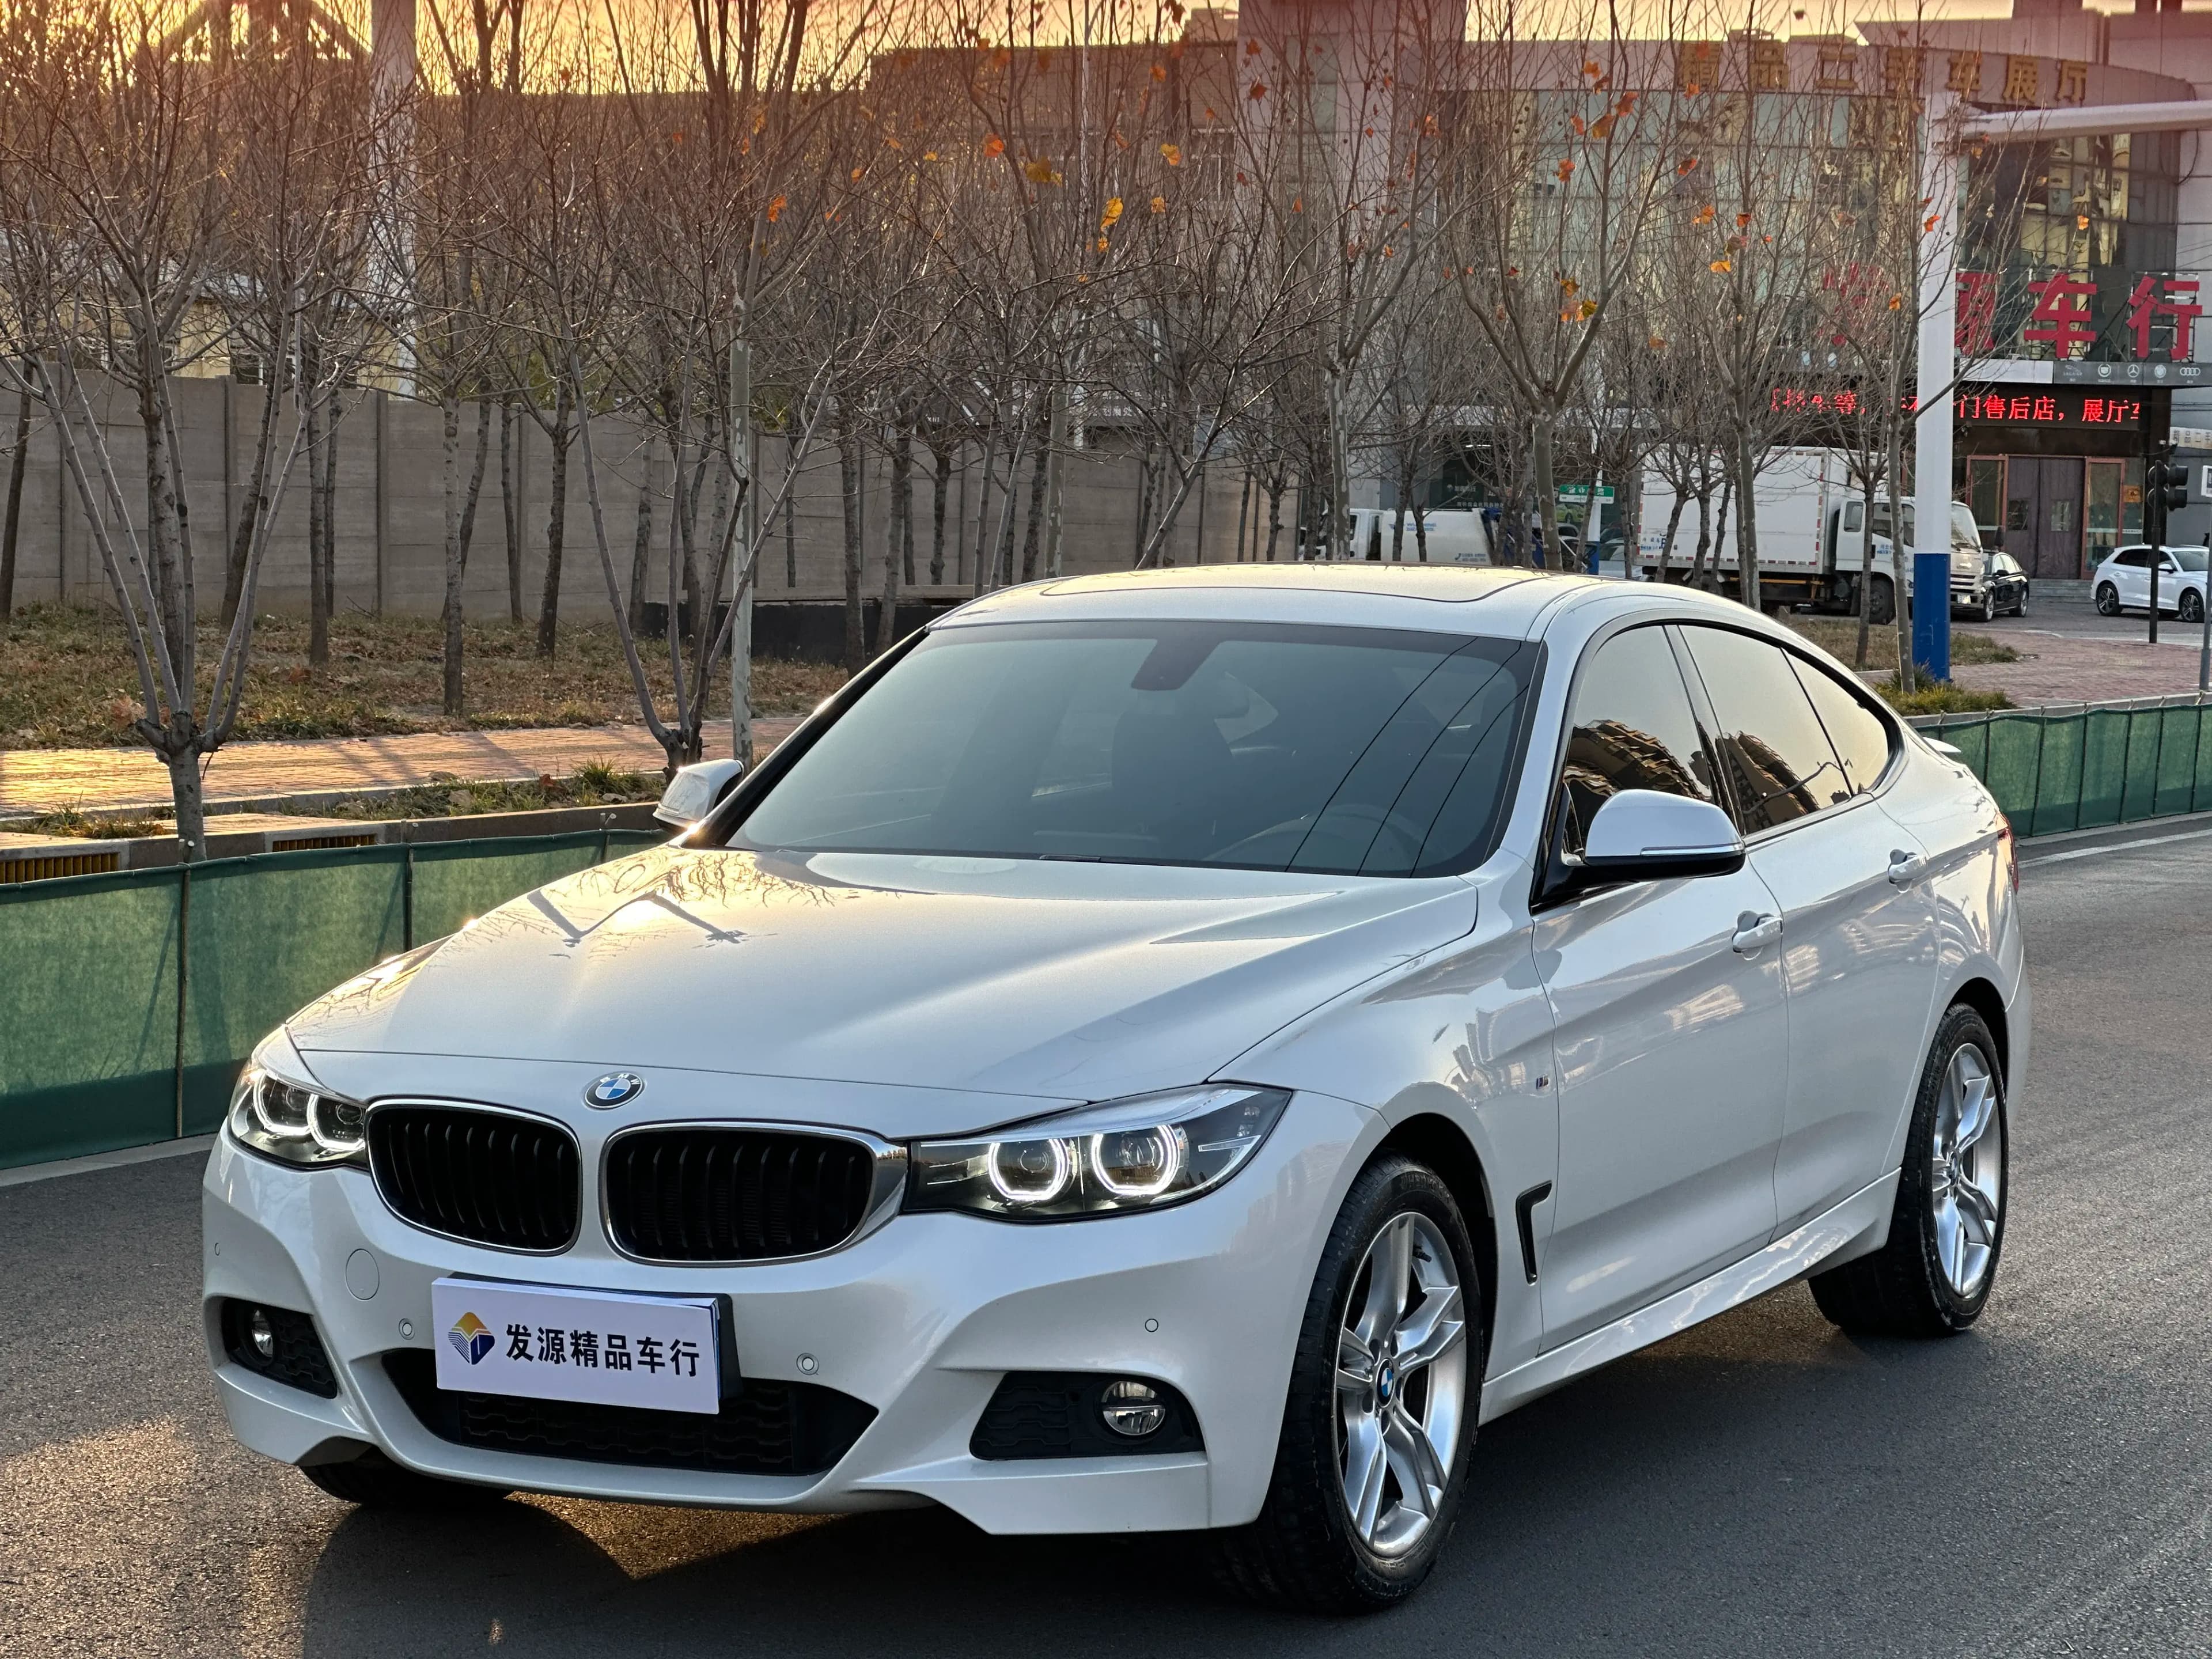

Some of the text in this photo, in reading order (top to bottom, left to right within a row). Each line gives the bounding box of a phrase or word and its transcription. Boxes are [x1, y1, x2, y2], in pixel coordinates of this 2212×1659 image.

[599, 1073, 641, 1085] BMW
[505, 1323, 700, 1377] 发源精品车行
